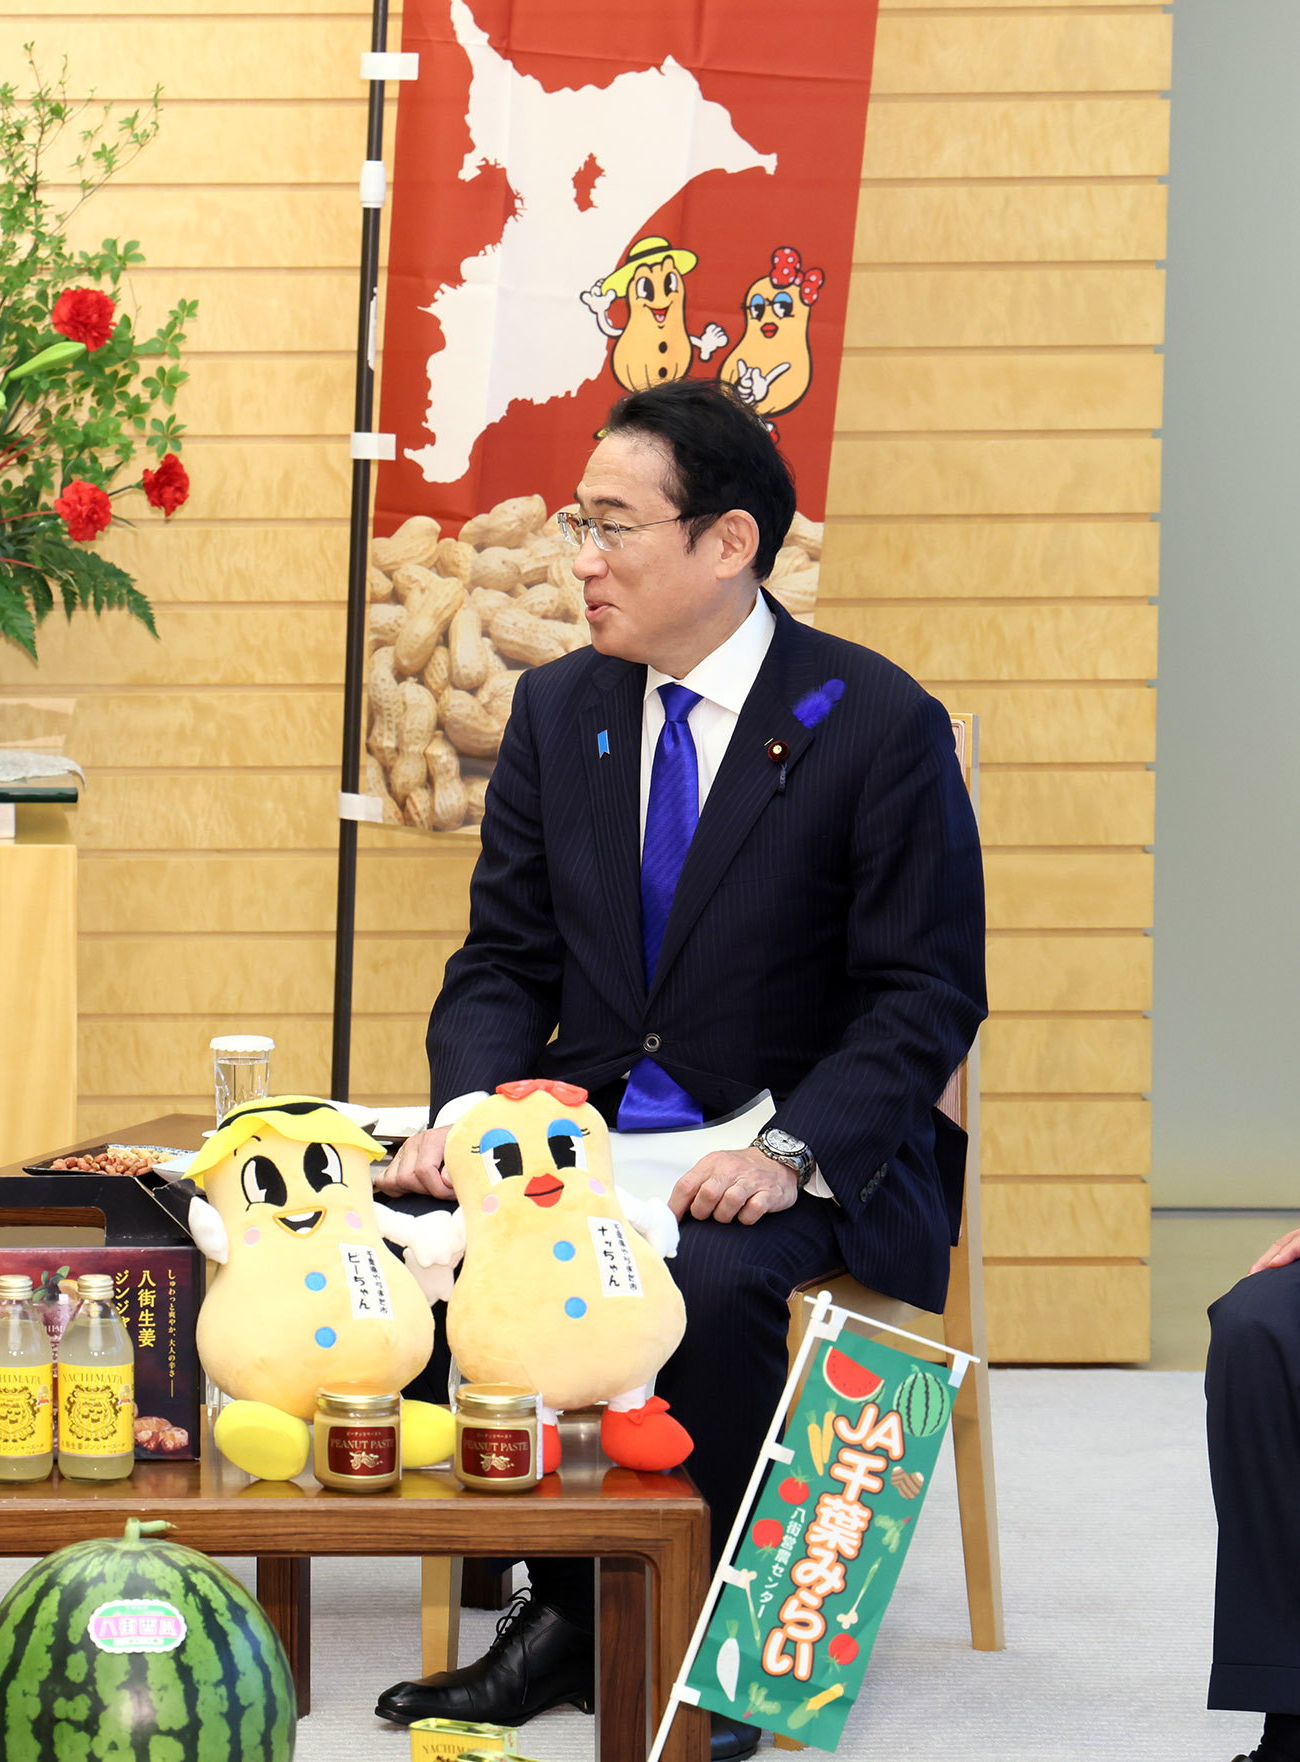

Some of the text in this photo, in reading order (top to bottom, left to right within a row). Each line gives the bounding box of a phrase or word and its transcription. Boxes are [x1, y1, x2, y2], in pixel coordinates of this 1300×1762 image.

[597, 1225, 621, 1287] ナッちゃん
[137, 1269, 157, 1348] 八街生姜
[62, 1373, 124, 1384] YACHIMATA
[330, 1438, 394, 1449] PEANUT PASTE
[463, 1440, 529, 1452] PEANUT PASTE
[763, 1405, 905, 1680] JA千葉みらい
